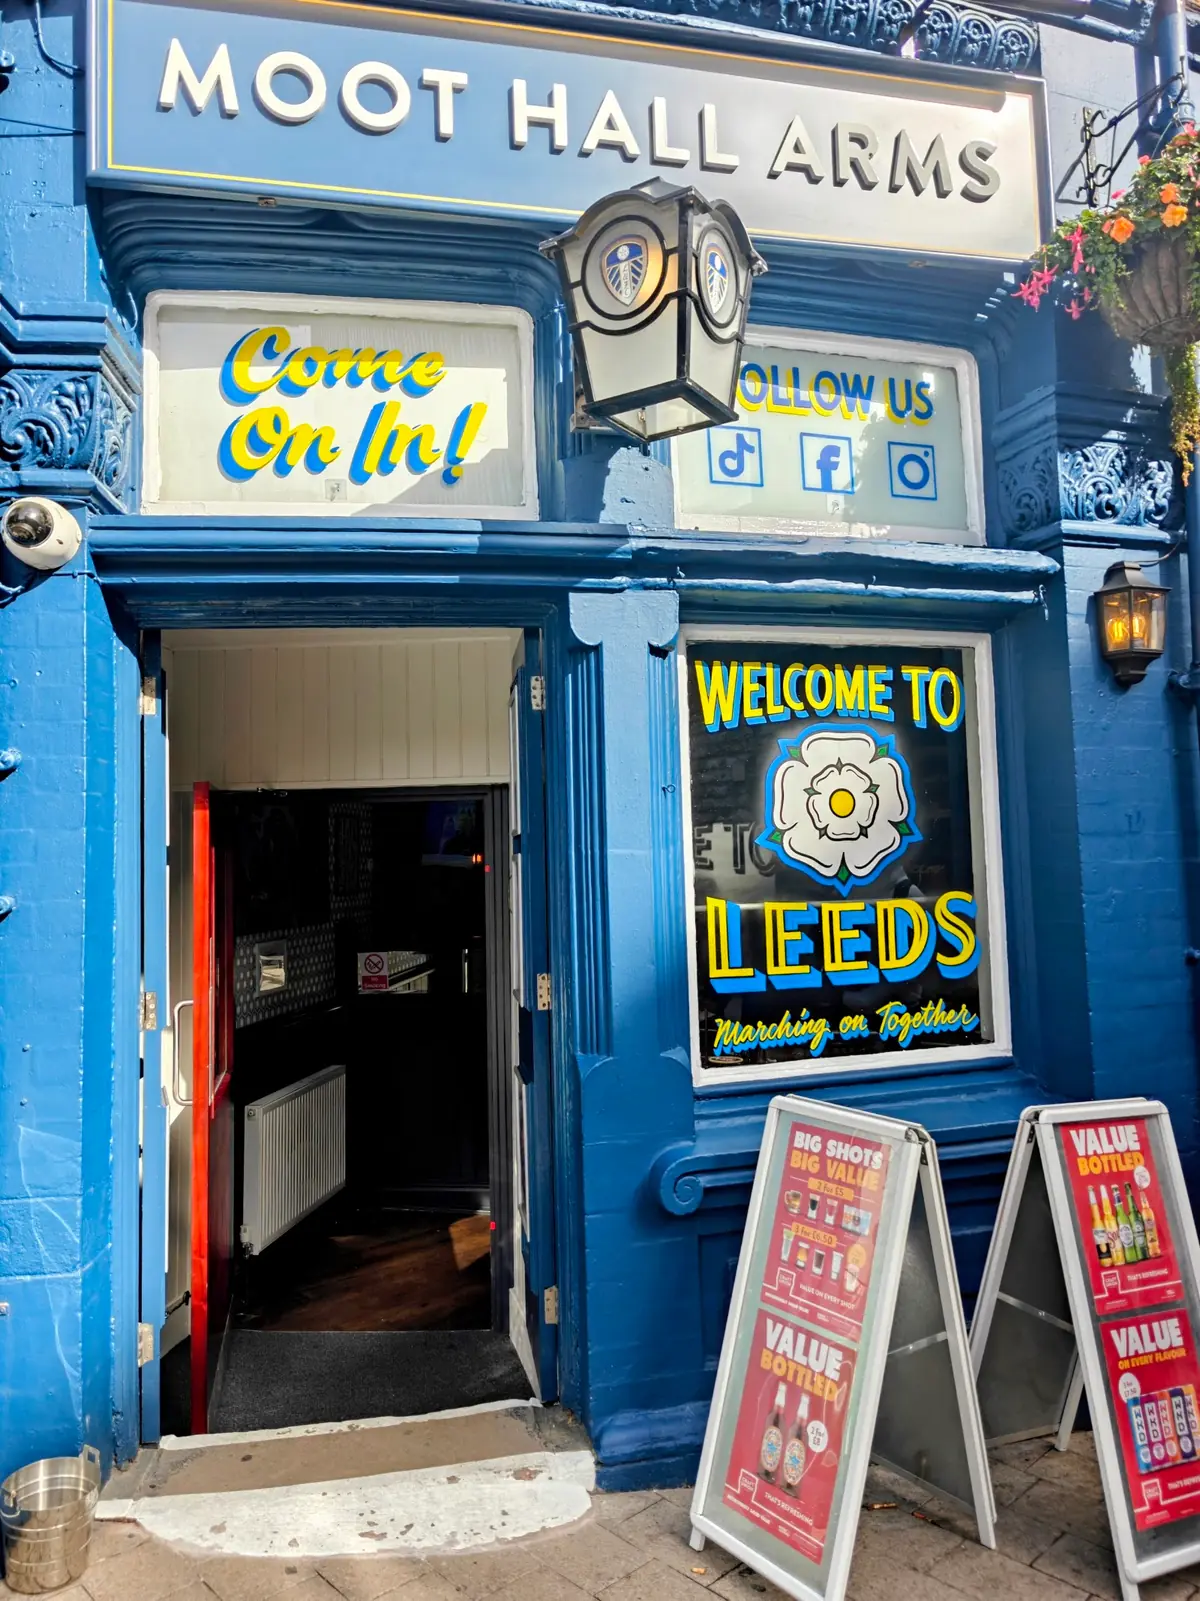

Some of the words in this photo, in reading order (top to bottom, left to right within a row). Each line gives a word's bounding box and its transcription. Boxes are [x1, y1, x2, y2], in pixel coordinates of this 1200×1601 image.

[159, 37, 468, 142] MOOT
[510, 78, 741, 171] HALL
[768, 115, 1002, 203] ARMS
[219, 326, 448, 407] Come
[735, 362, 875, 421] OLLOW
[884, 376, 934, 425] US
[217, 405, 342, 484] On
[348, 400, 488, 487] In!
[694, 660, 895, 733] WELCOME
[901, 665, 966, 732] TO
[706, 891, 982, 994] LEEDS
[713, 1007, 834, 1057] Marching
[838, 1015, 870, 1041] on
[876, 998, 980, 1048] Together
[793, 1131, 822, 1153] BIG
[825, 1139, 884, 1170] SHOTS
[1069, 1124, 1141, 1157] VALUE
[1076, 1152, 1146, 1176] BOTTLED
[790, 1150, 820, 1174] BIG
[826, 1159, 881, 1192] VALUE
[765, 1317, 845, 1382] VALUE
[1110, 1318, 1184, 1359] VALUE
[1118, 1358, 1130, 1371] ON
[1131, 1354, 1154, 1369] EVERY
[1155, 1347, 1187, 1364] FLAVOUR
[759, 1348, 839, 1402] BOTTLED
